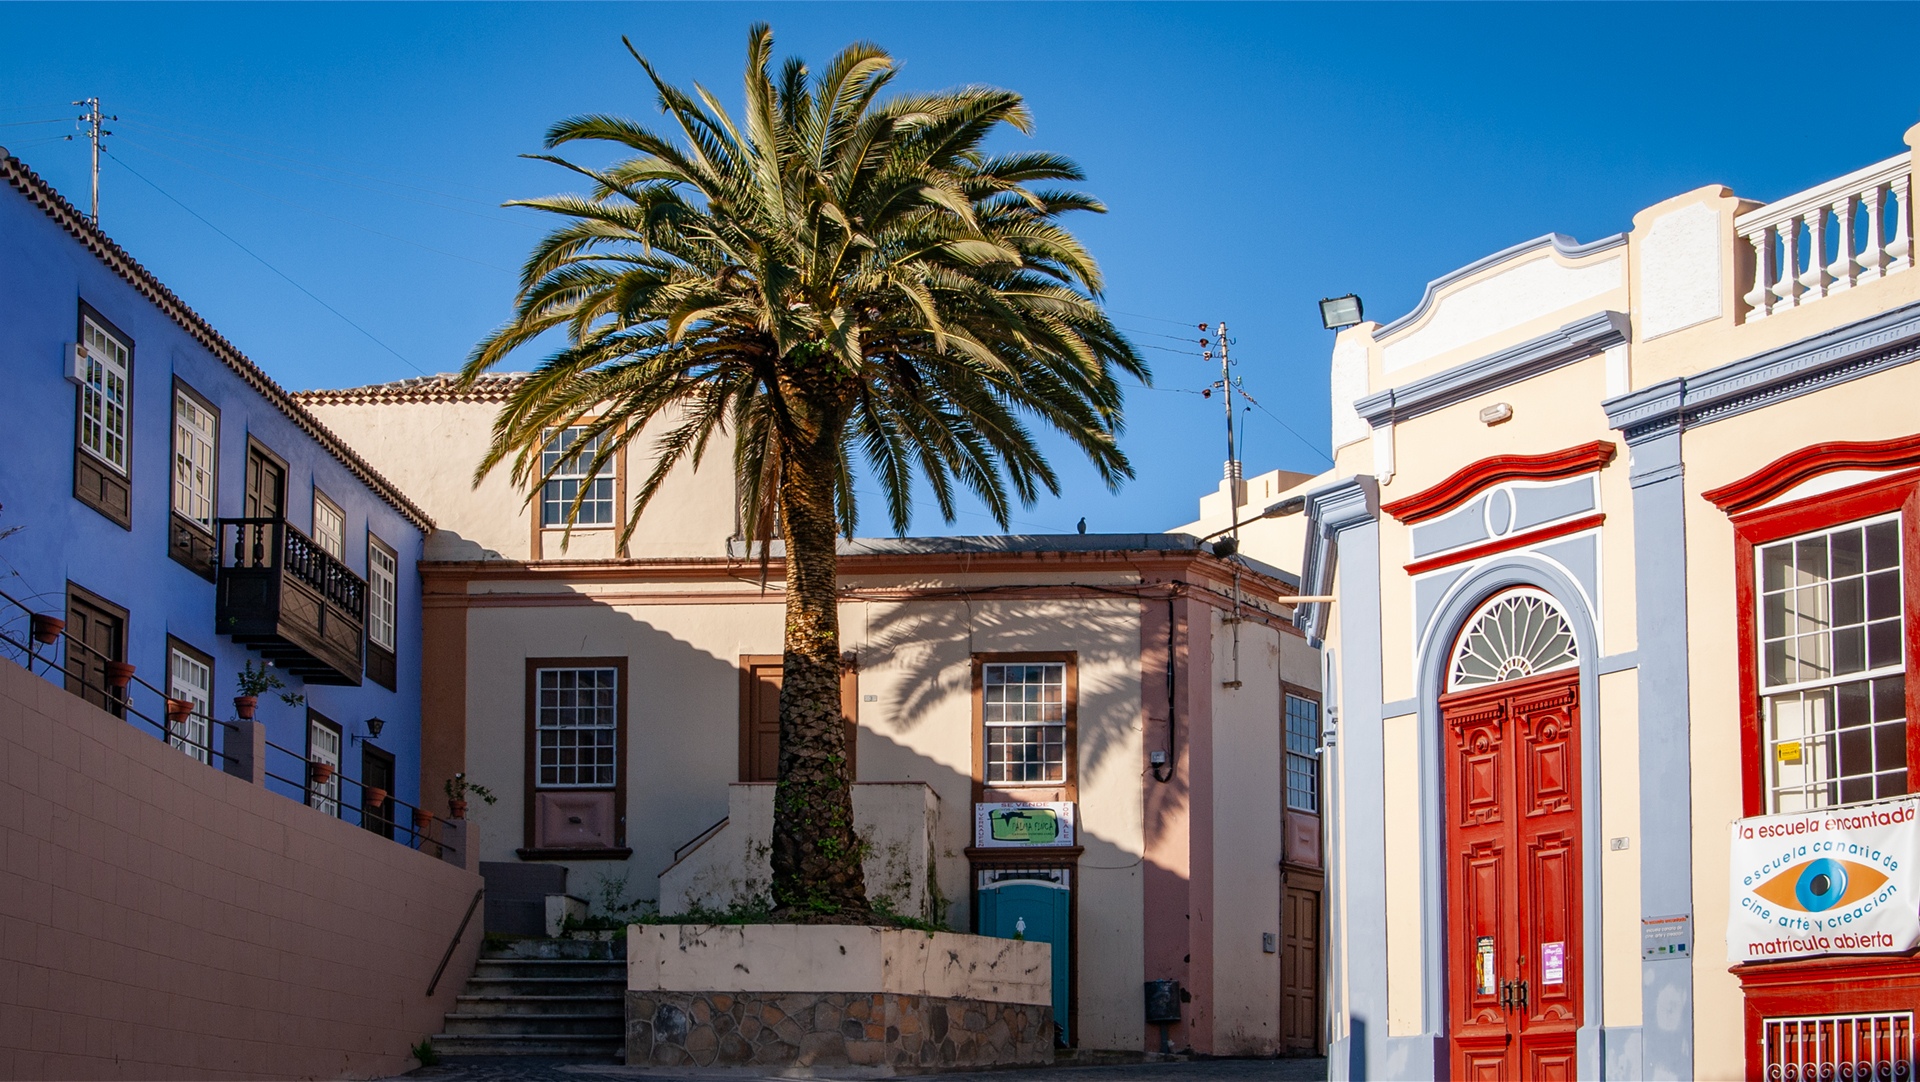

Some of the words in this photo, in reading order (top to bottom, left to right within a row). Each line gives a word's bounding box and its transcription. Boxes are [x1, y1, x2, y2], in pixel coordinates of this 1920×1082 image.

[1739, 825, 1754, 840] la
[1758, 818, 1820, 838] escuela
[1824, 807, 1915, 831] encantada
[1743, 845, 1807, 886] escuela
[1812, 841, 1881, 862] canaria
[1882, 855, 1898, 872] de
[1741, 897, 1772, 924] cine,
[1778, 916, 1810, 931] arte
[1813, 919, 1823, 932] y
[1827, 885, 1897, 928] creación
[1748, 934, 1831, 956] matrícula
[1833, 931, 1894, 949] abierta
